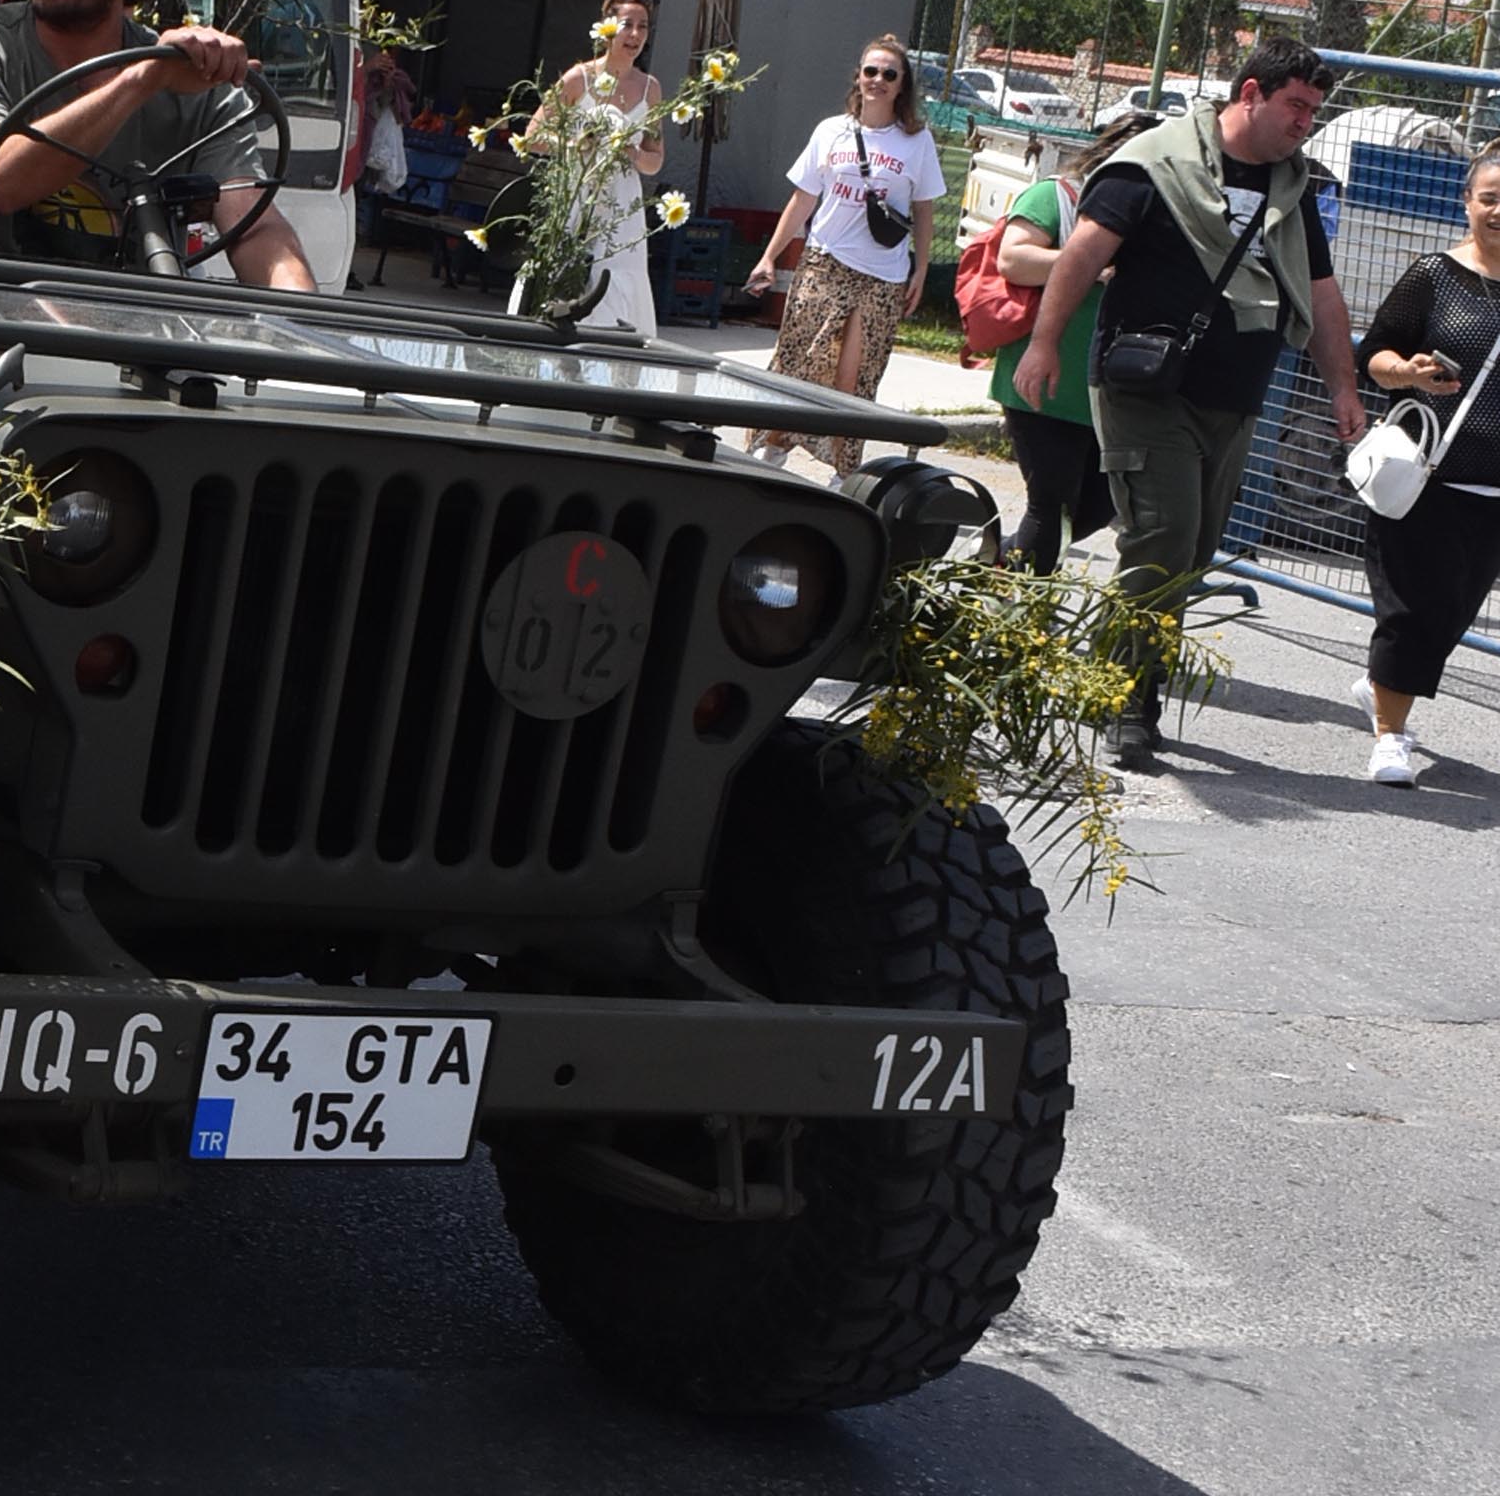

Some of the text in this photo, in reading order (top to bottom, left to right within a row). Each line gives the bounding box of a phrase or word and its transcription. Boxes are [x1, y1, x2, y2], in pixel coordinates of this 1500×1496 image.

[868, 152, 904, 175] TIMES
[565, 540, 606, 596] C
[215, 1022, 470, 1086] 34 GTA
[872, 1034, 985, 1111] 12A
[199, 1132, 225, 1151] TR
[292, 1092, 386, 1152] 154
